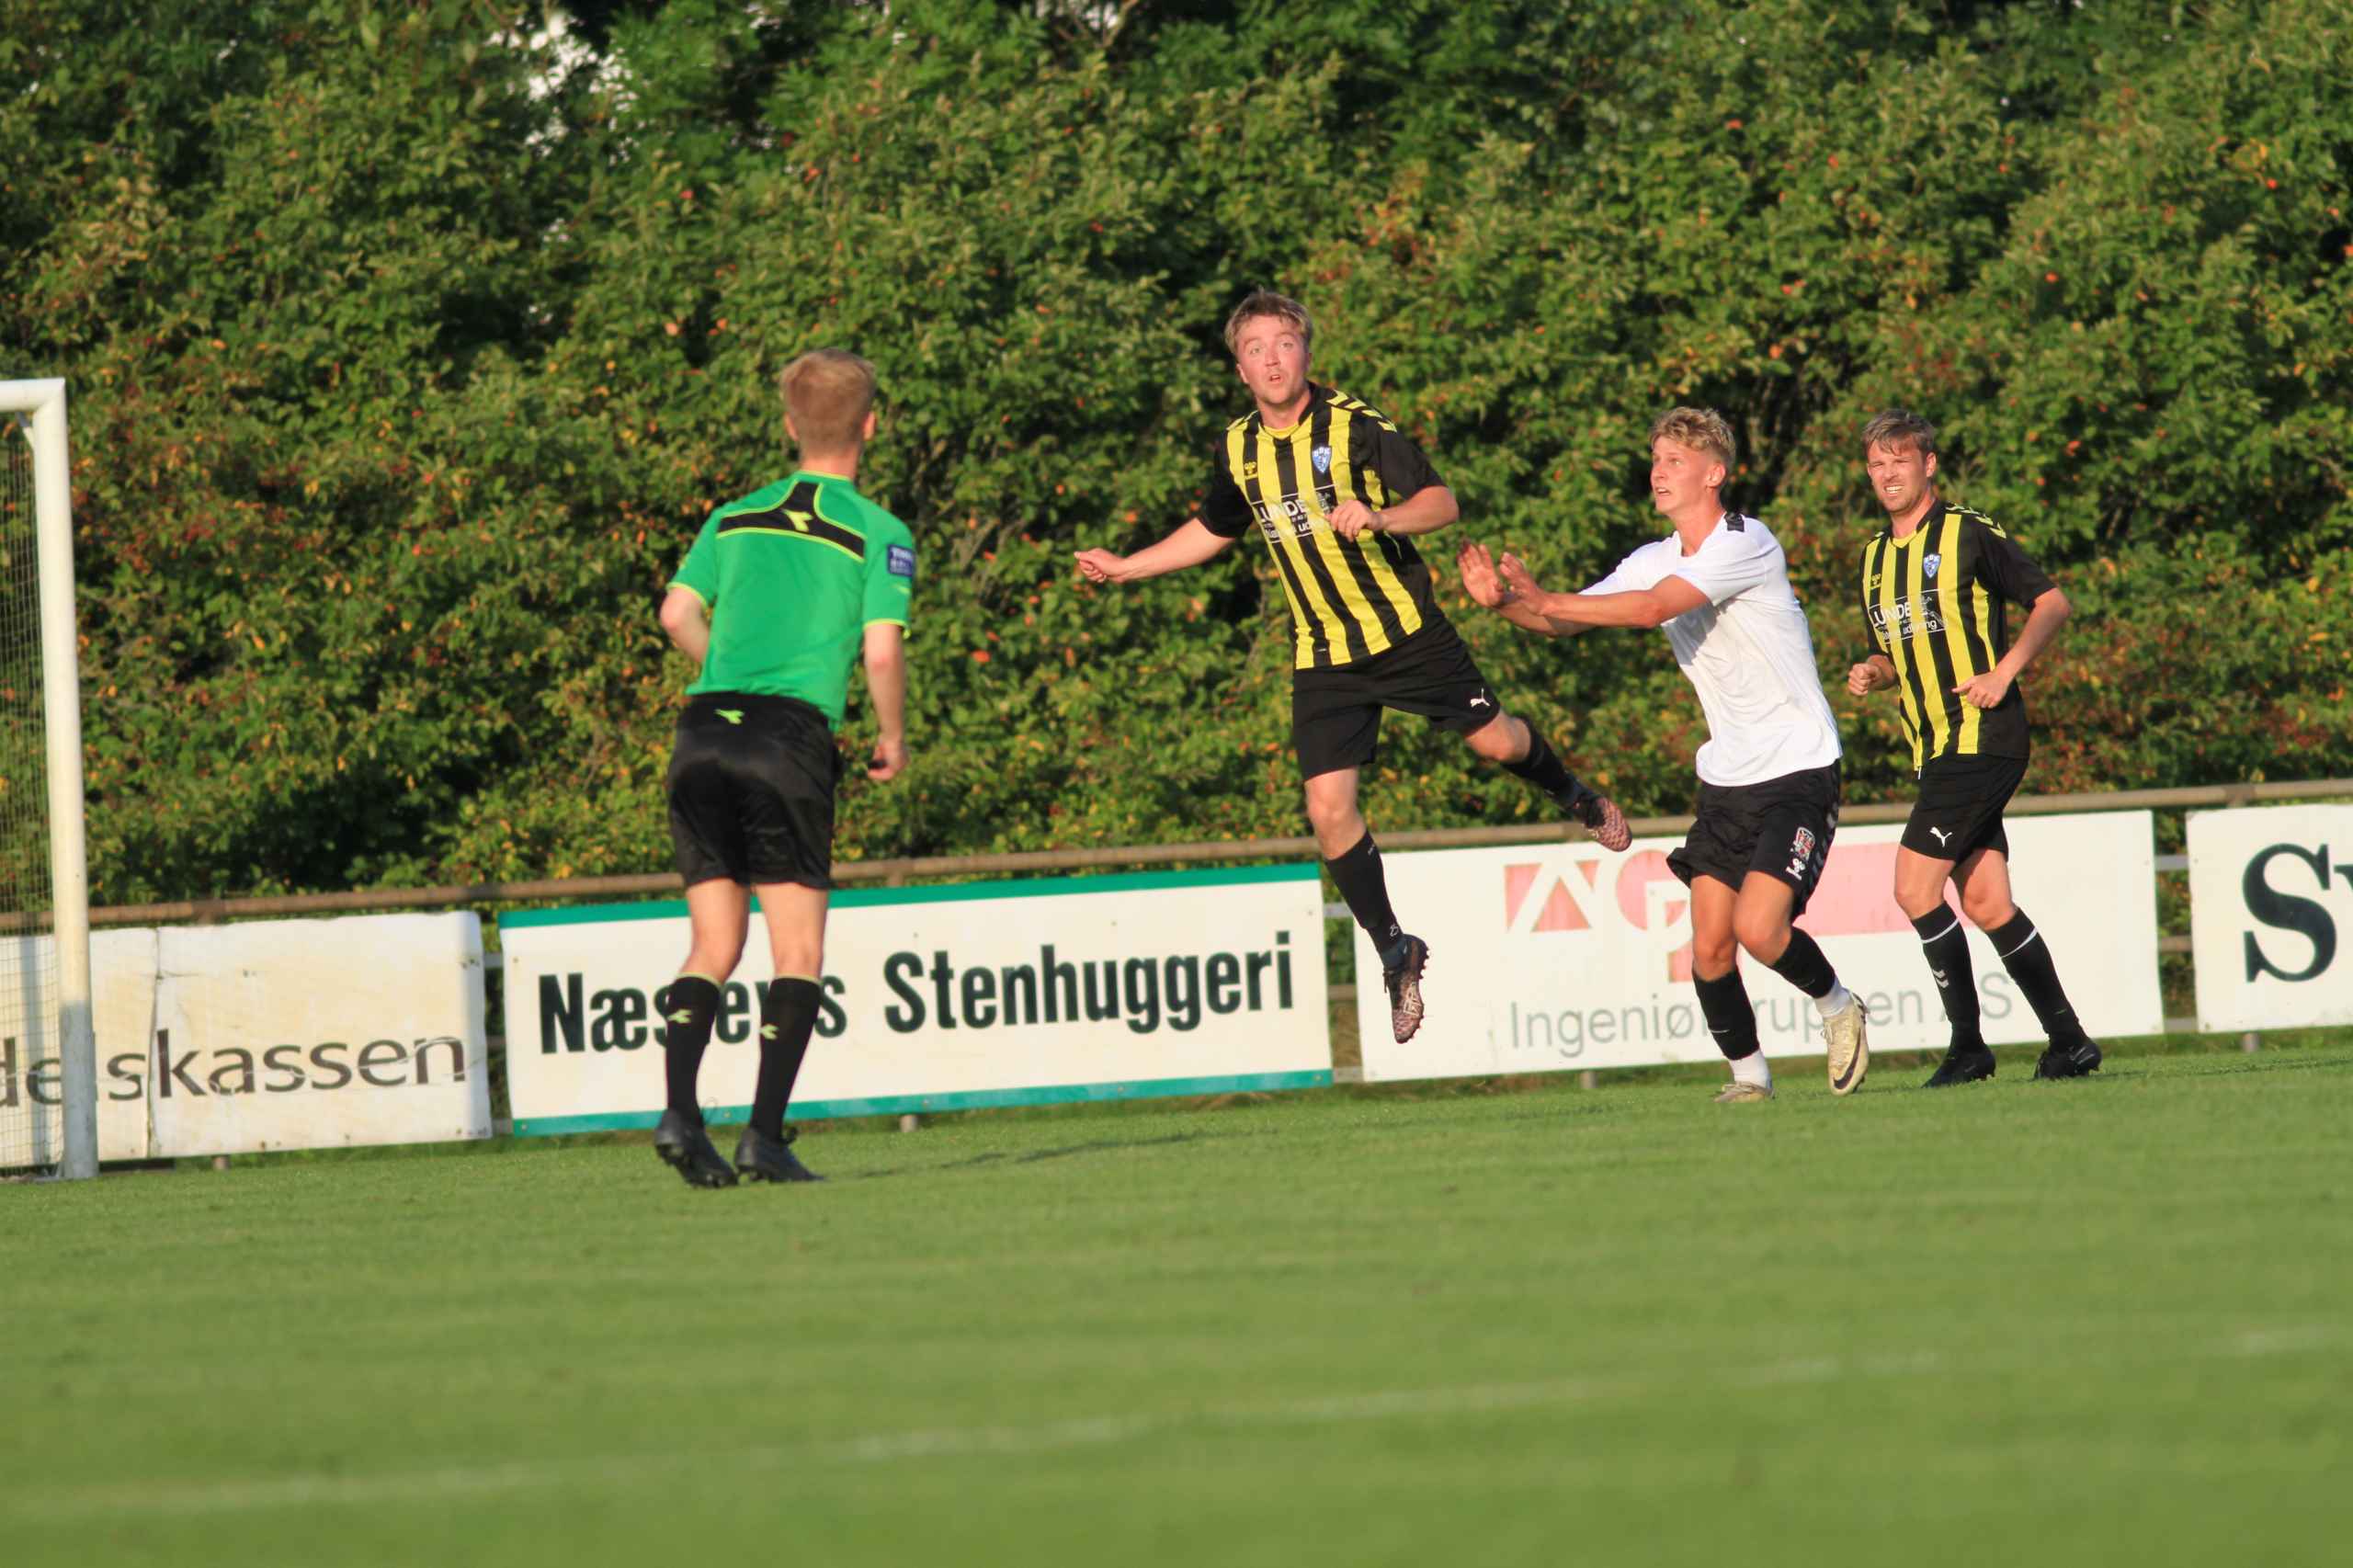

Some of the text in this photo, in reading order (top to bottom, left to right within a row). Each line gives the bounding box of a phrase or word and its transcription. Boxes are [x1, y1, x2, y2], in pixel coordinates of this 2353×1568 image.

[2243, 843, 2353, 983] S
[883, 930, 1293, 1034] Stenhuggeri
[0, 1028, 467, 1108] eskassen
